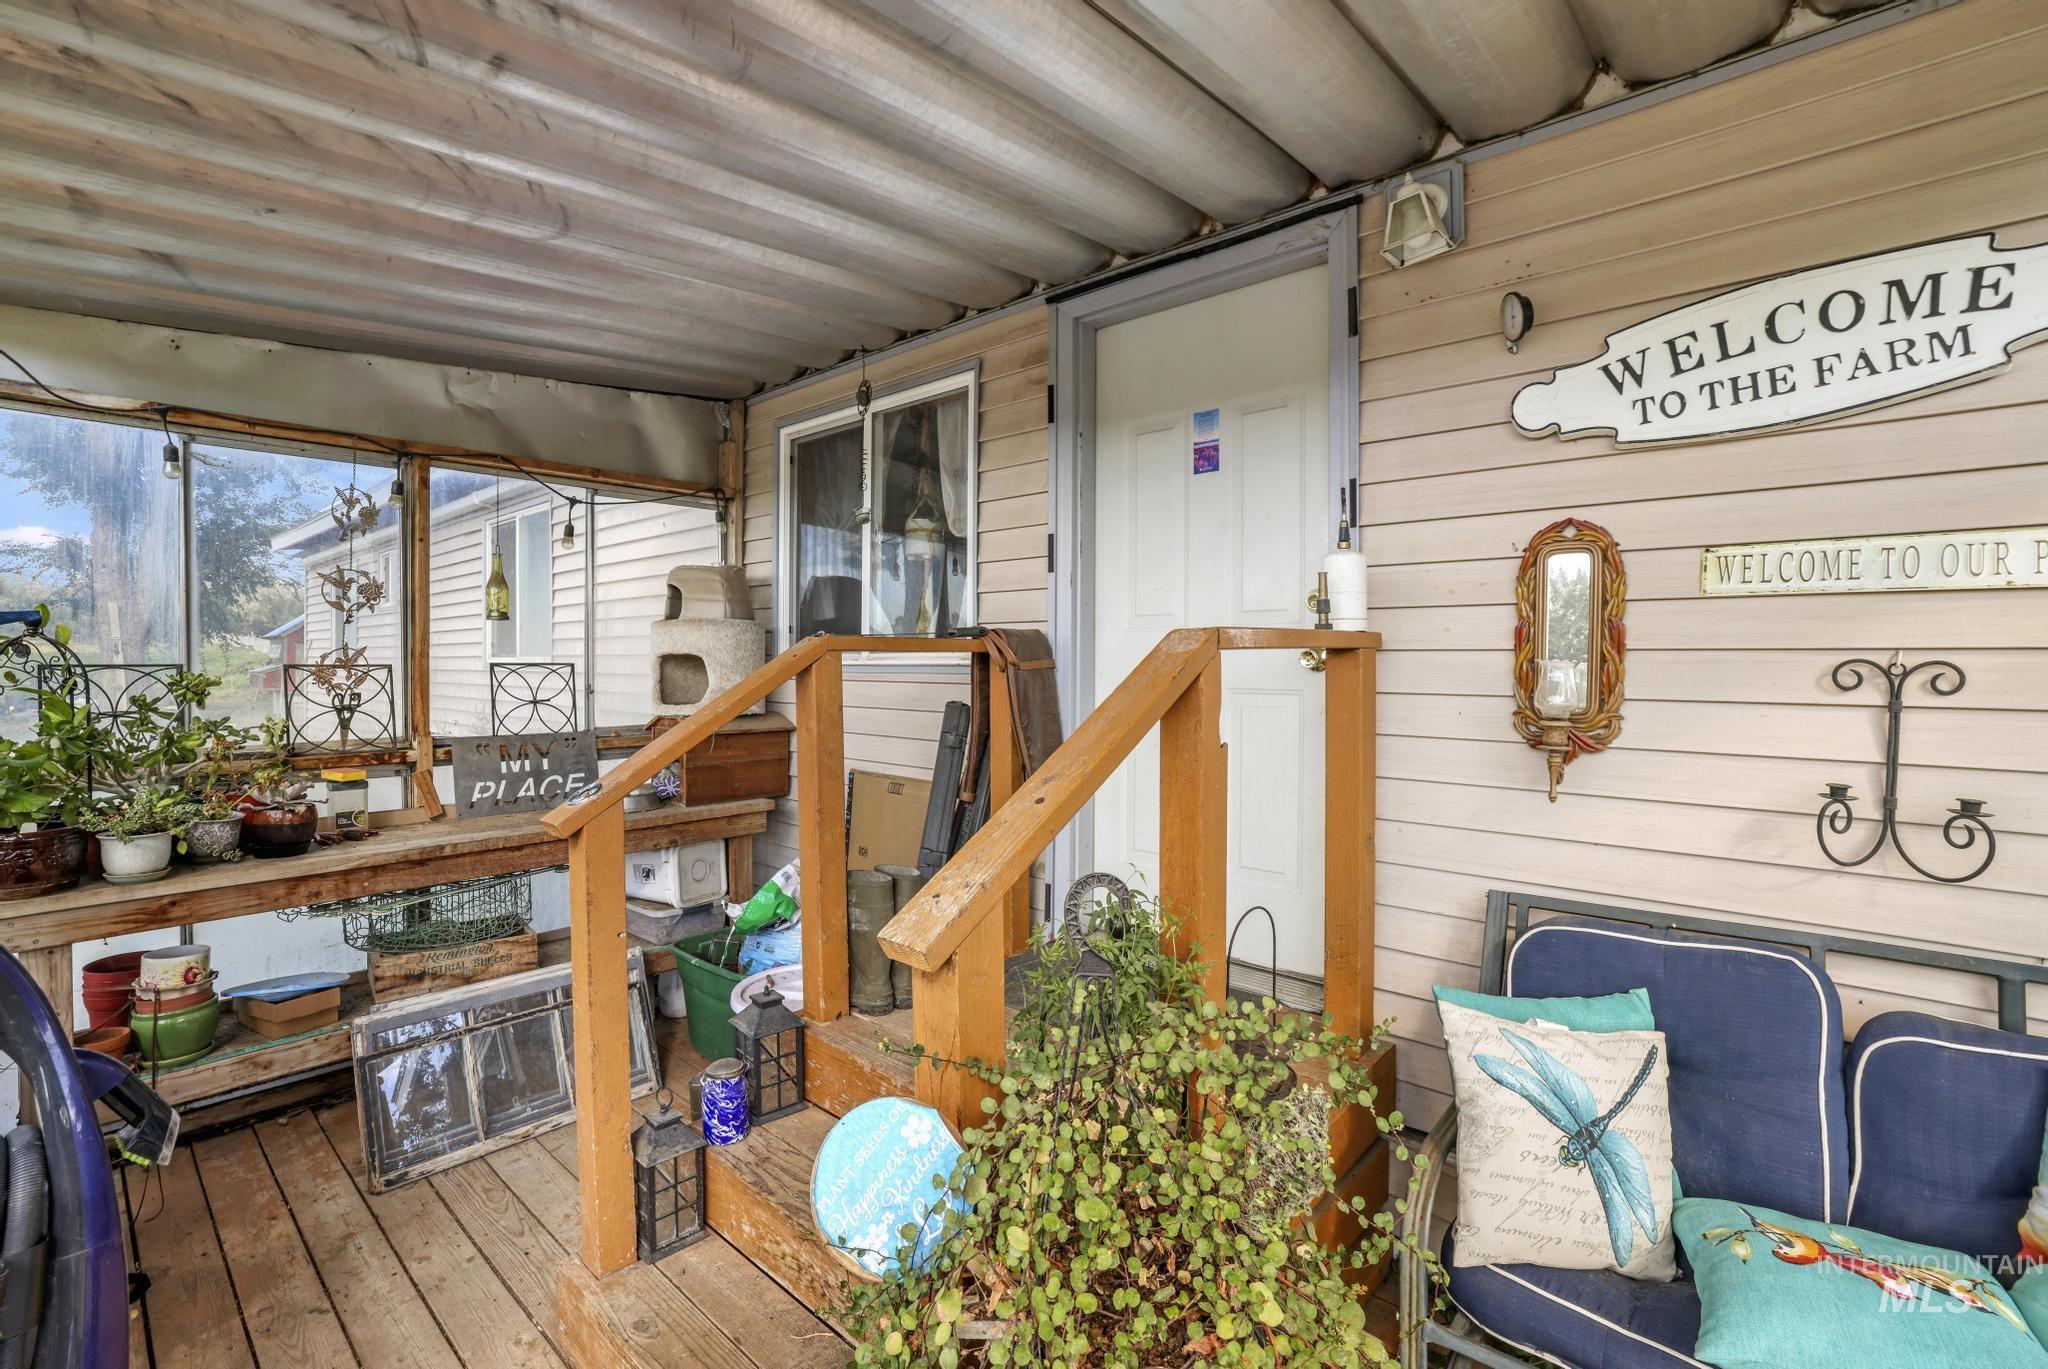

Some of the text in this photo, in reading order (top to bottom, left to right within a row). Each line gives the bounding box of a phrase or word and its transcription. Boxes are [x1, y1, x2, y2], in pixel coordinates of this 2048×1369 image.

[1597, 262, 2016, 396] WELCOME
[1632, 323, 1977, 426] TO THE FARM
[1715, 547, 1864, 585] WELCOME
[1880, 545, 1922, 580] TO
[1941, 541, 2014, 578] OUR
[469, 772, 586, 809] PLACE
[473, 953, 513, 968] SHELLS
[816, 1164, 856, 1214] PLANT
[853, 1121, 890, 1167] SEEDS
[827, 1142, 908, 1238] Happiness
[881, 1130, 950, 1216] Kindness
